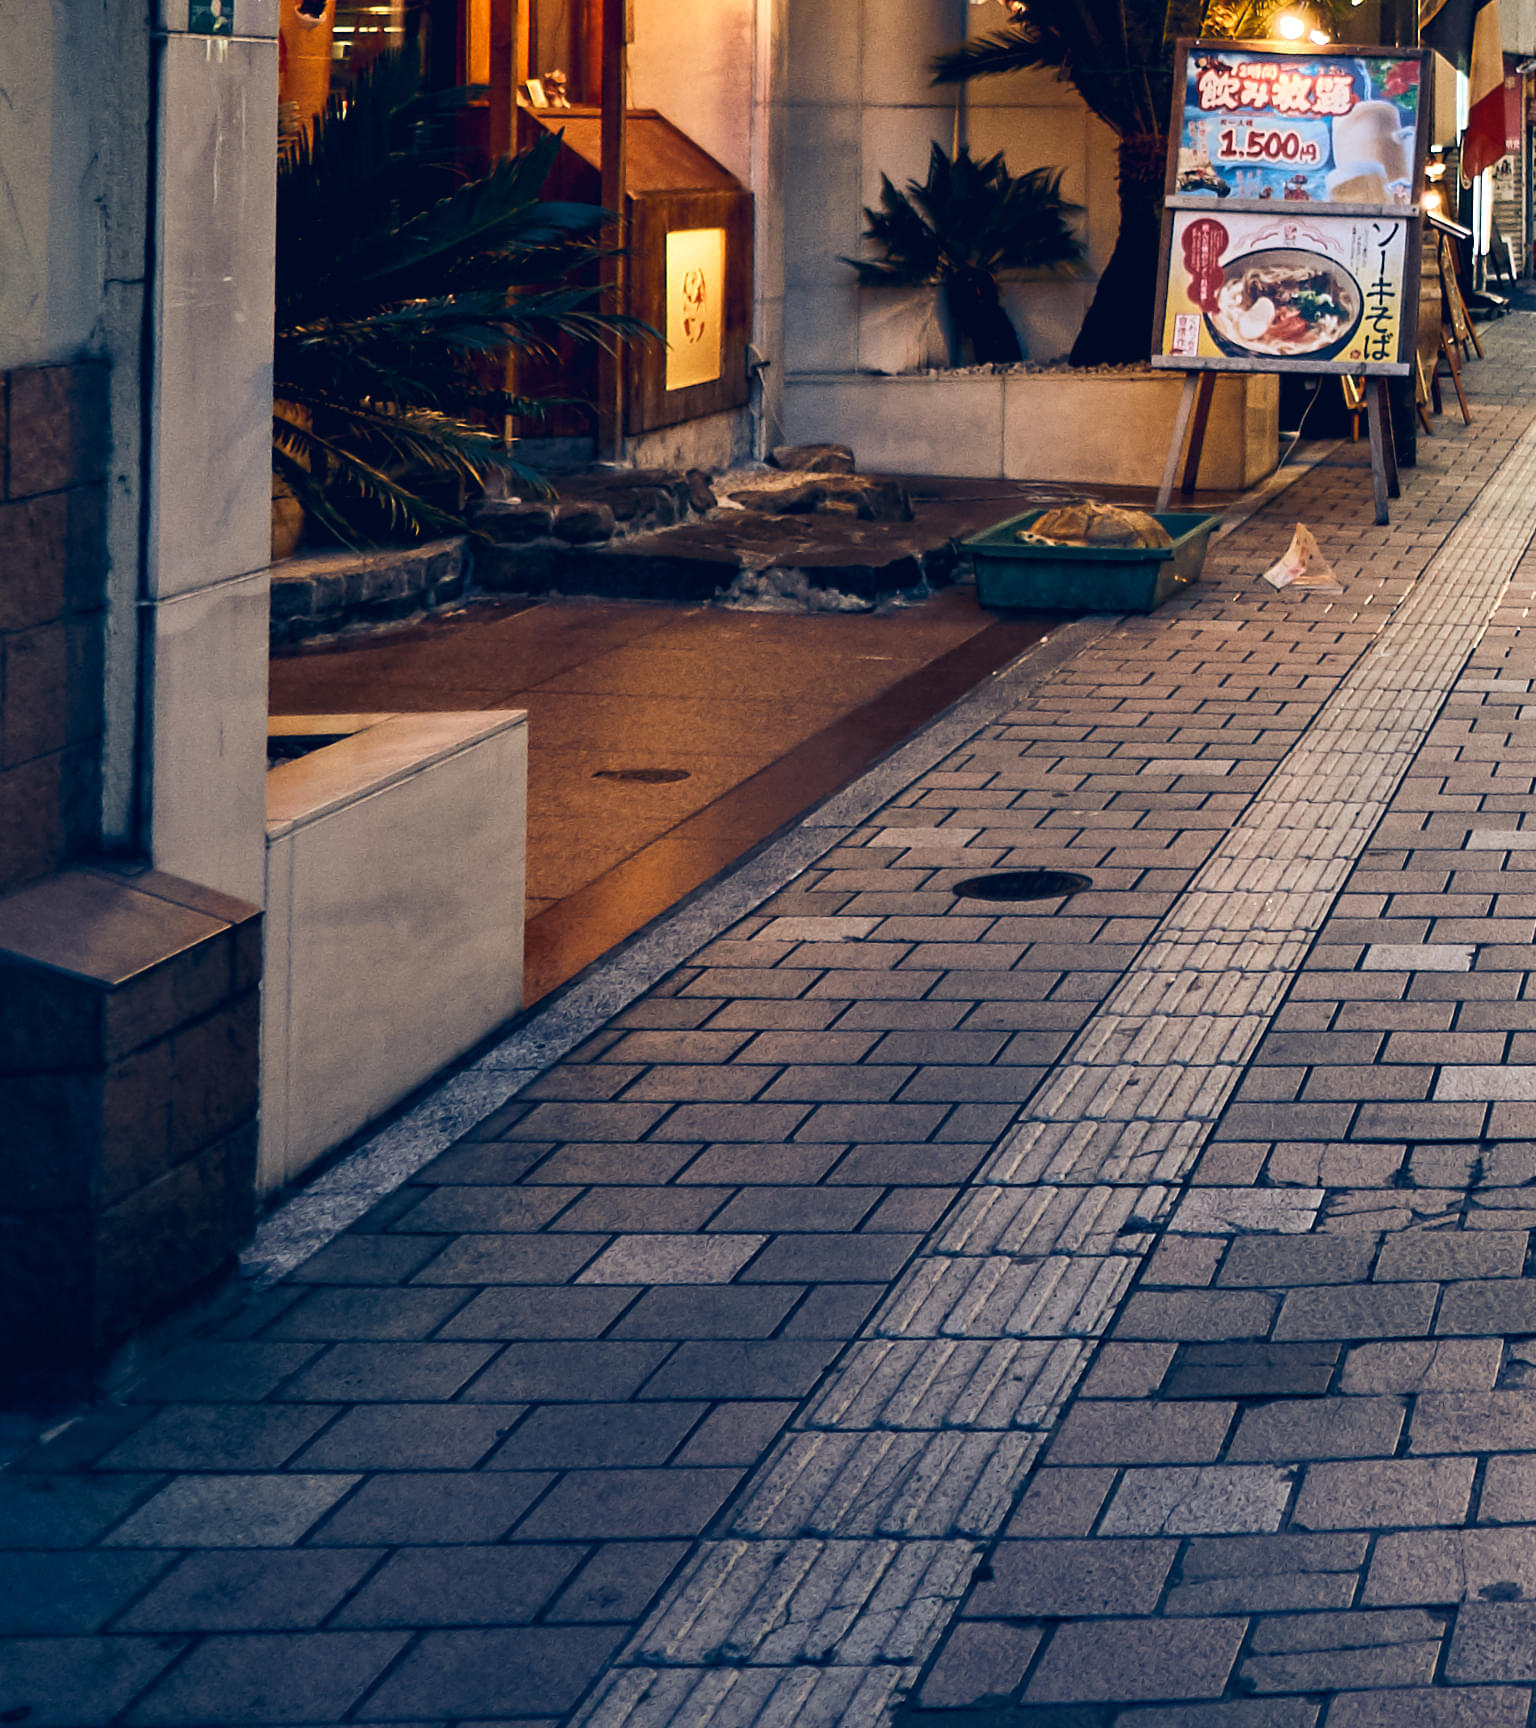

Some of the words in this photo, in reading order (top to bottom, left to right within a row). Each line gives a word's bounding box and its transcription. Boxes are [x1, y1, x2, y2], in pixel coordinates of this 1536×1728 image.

[1198, 69, 1354, 114] 飲み放題
[1365, 222, 1400, 362] ソーキそば
